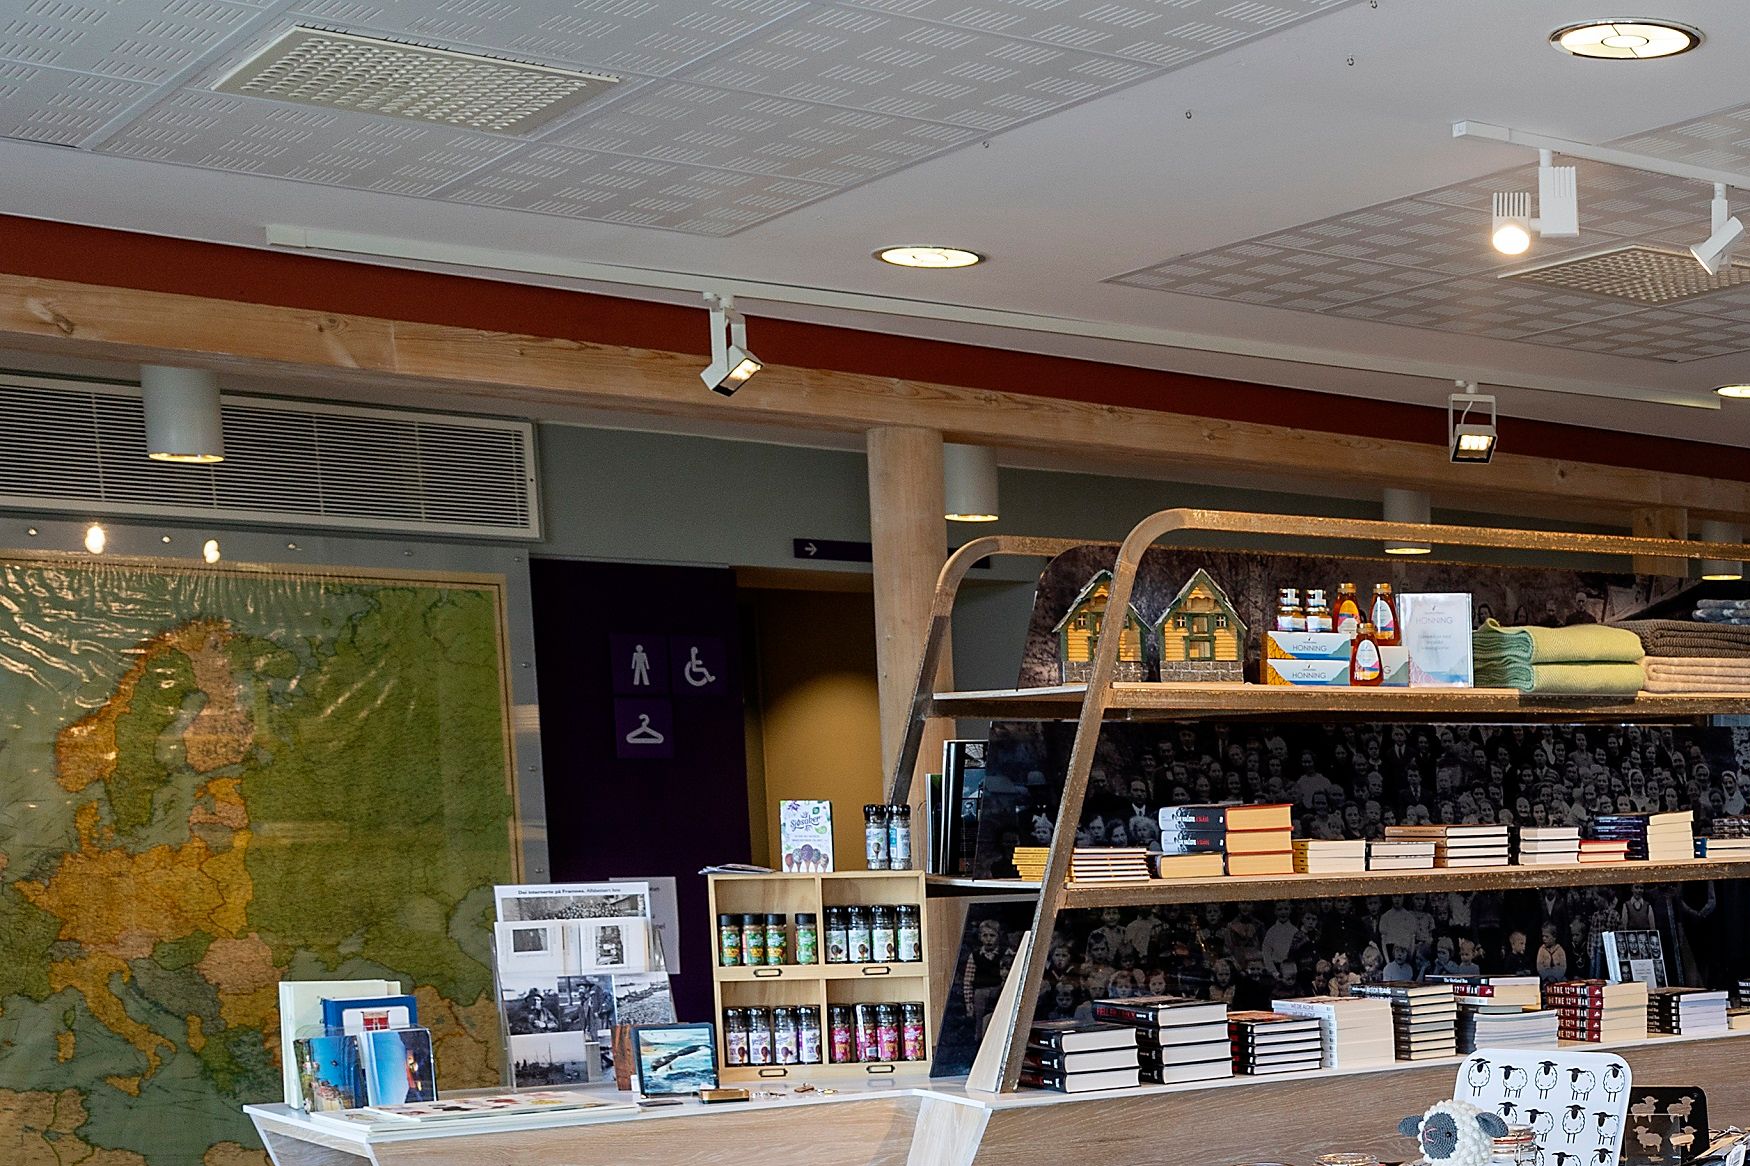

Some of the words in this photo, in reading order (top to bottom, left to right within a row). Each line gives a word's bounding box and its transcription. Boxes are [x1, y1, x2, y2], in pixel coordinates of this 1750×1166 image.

[1416, 616, 1453, 625] HONNING
[1466, 985, 1478, 994] MAN
[1553, 986, 1563, 995] THE
[1576, 986, 1588, 995] MAN
[1555, 997, 1565, 1005] THE
[1577, 997, 1588, 1006] MAN
[1576, 1009, 1587, 1017] MAN
[1576, 1019, 1587, 1028] MAN
[1576, 1030, 1587, 1039] MAN
